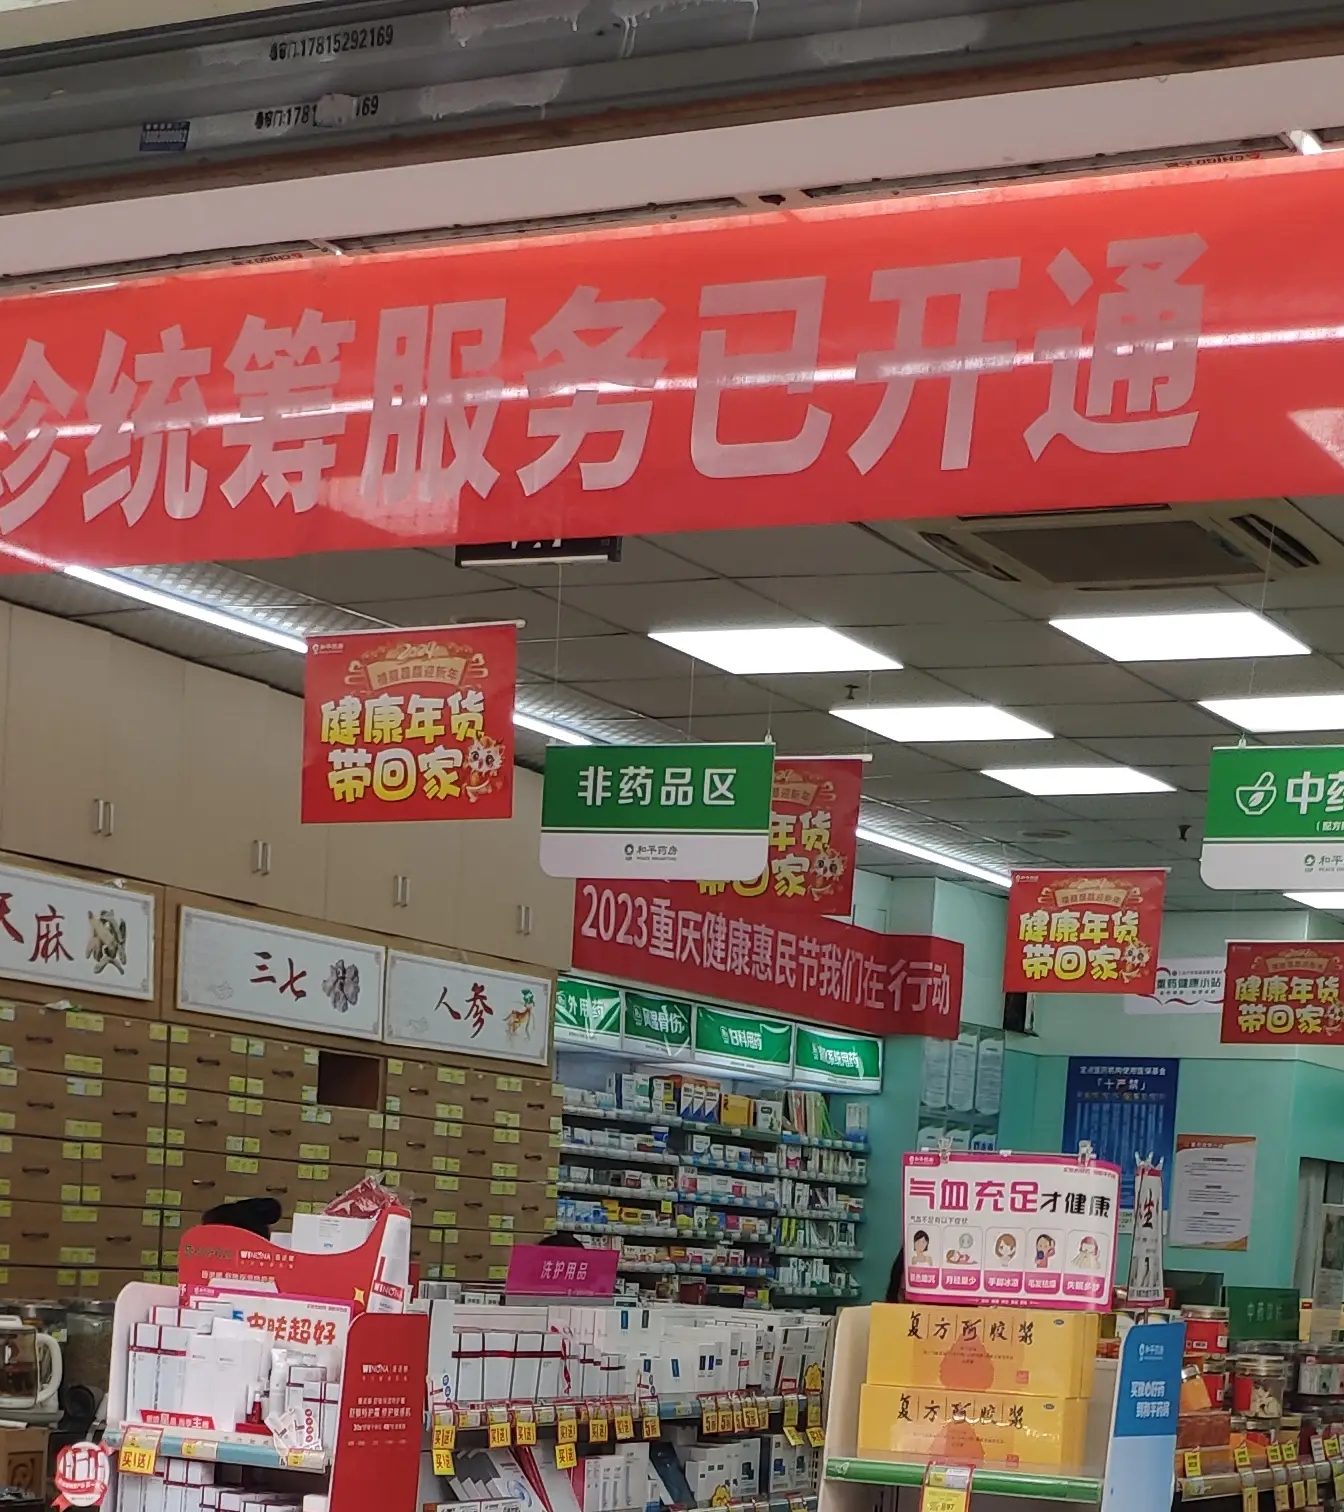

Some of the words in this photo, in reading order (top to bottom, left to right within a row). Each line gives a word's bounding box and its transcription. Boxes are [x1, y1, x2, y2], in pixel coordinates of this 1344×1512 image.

[396, 641, 438, 659] 2024
[320, 690, 485, 745] 健康年货
[327, 745, 464, 803] 带回家
[577, 765, 738, 807] 非药品区
[636, 844, 678, 856] 和平药房
[1019, 909, 1140, 946] 健康年货
[581, 884, 951, 1017] 2023重庆健康惠民节我们在行动
[1021, 944, 1122, 981] 带回家
[252, 950, 308, 1002] 三七
[1235, 975, 1341, 1005] 健康年货
[434, 982, 495, 1040] 人参
[567, 995, 605, 1020] 外用药
[1237, 1003, 1324, 1034] 带回家
[909, 1177, 1111, 1218] 气血充足才健康
[540, 1260, 589, 1281] 洗护用品
[906, 1310, 1035, 1346] 复方阿胶浆
[896, 1392, 1025, 1431] 复方阿胶浆
[121, 1451, 152, 1470] 买1送1
